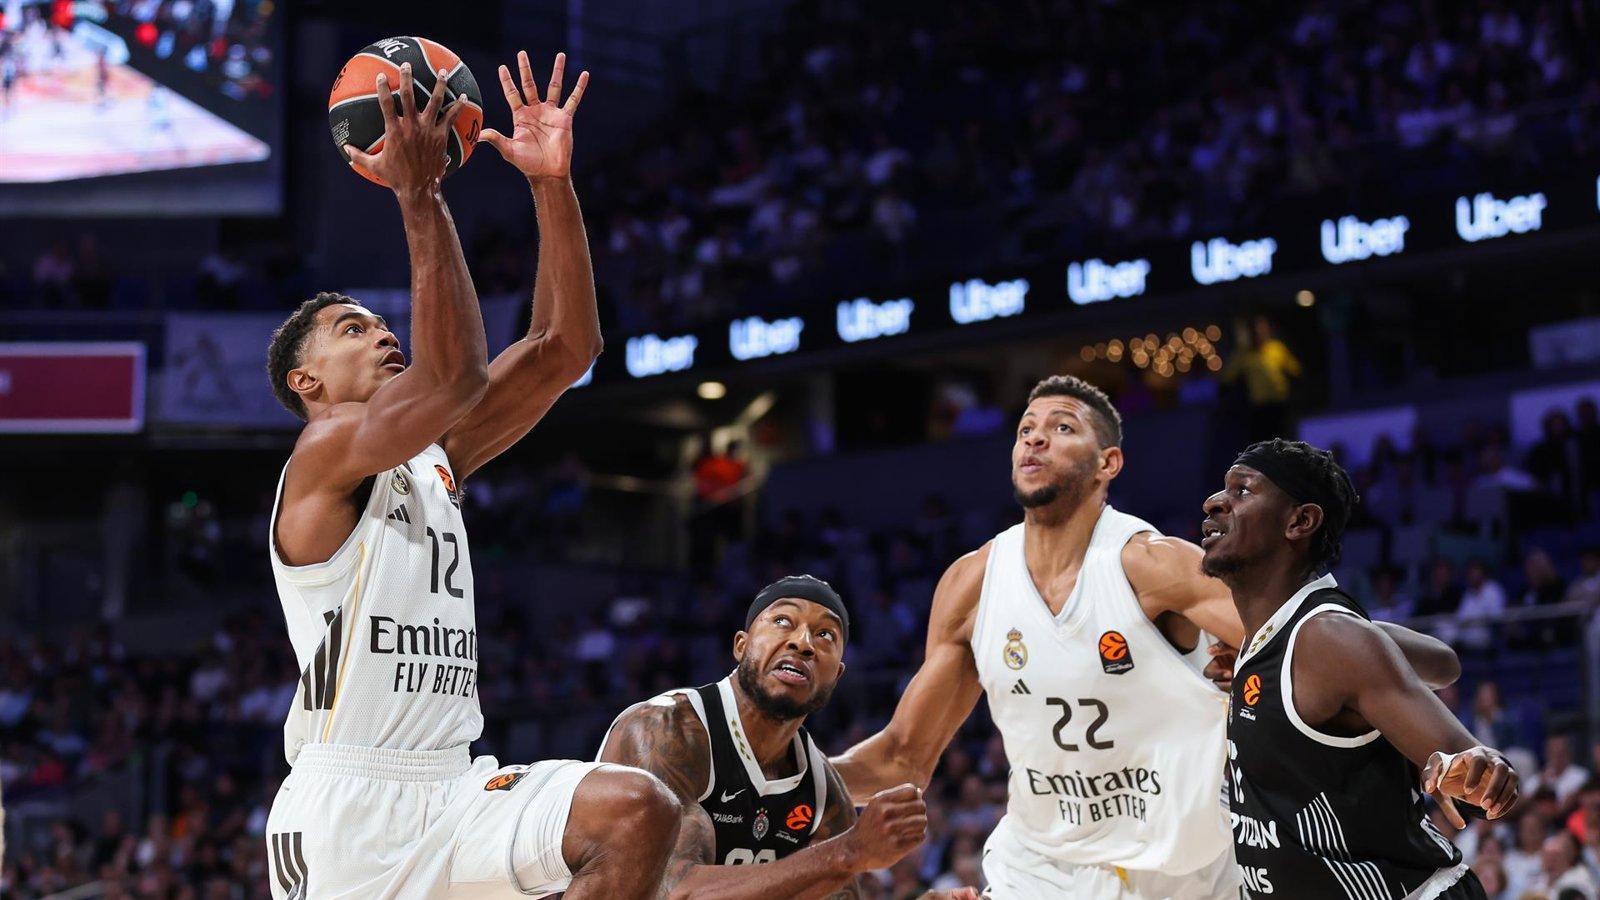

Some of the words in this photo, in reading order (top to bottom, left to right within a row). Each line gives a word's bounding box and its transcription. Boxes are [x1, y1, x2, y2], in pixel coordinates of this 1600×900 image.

[1456, 193, 1546, 241] Uber
[1191, 238, 1276, 284] Uber
[1321, 216, 1408, 263] Uber
[950, 280, 1028, 323] Uber
[1068, 260, 1149, 304] Uber
[730, 317, 803, 360] Uber
[837, 299, 913, 342] Uber
[626, 335, 697, 377] Uber
[426, 525, 464, 599] 12
[369, 615, 478, 662] Emirat
[393, 662, 429, 693] FLY
[1046, 697, 1115, 752] 22
[1026, 766, 1162, 799] Emirates
[1058, 799, 1082, 826] FLY
[1089, 793, 1147, 823] BETTER
